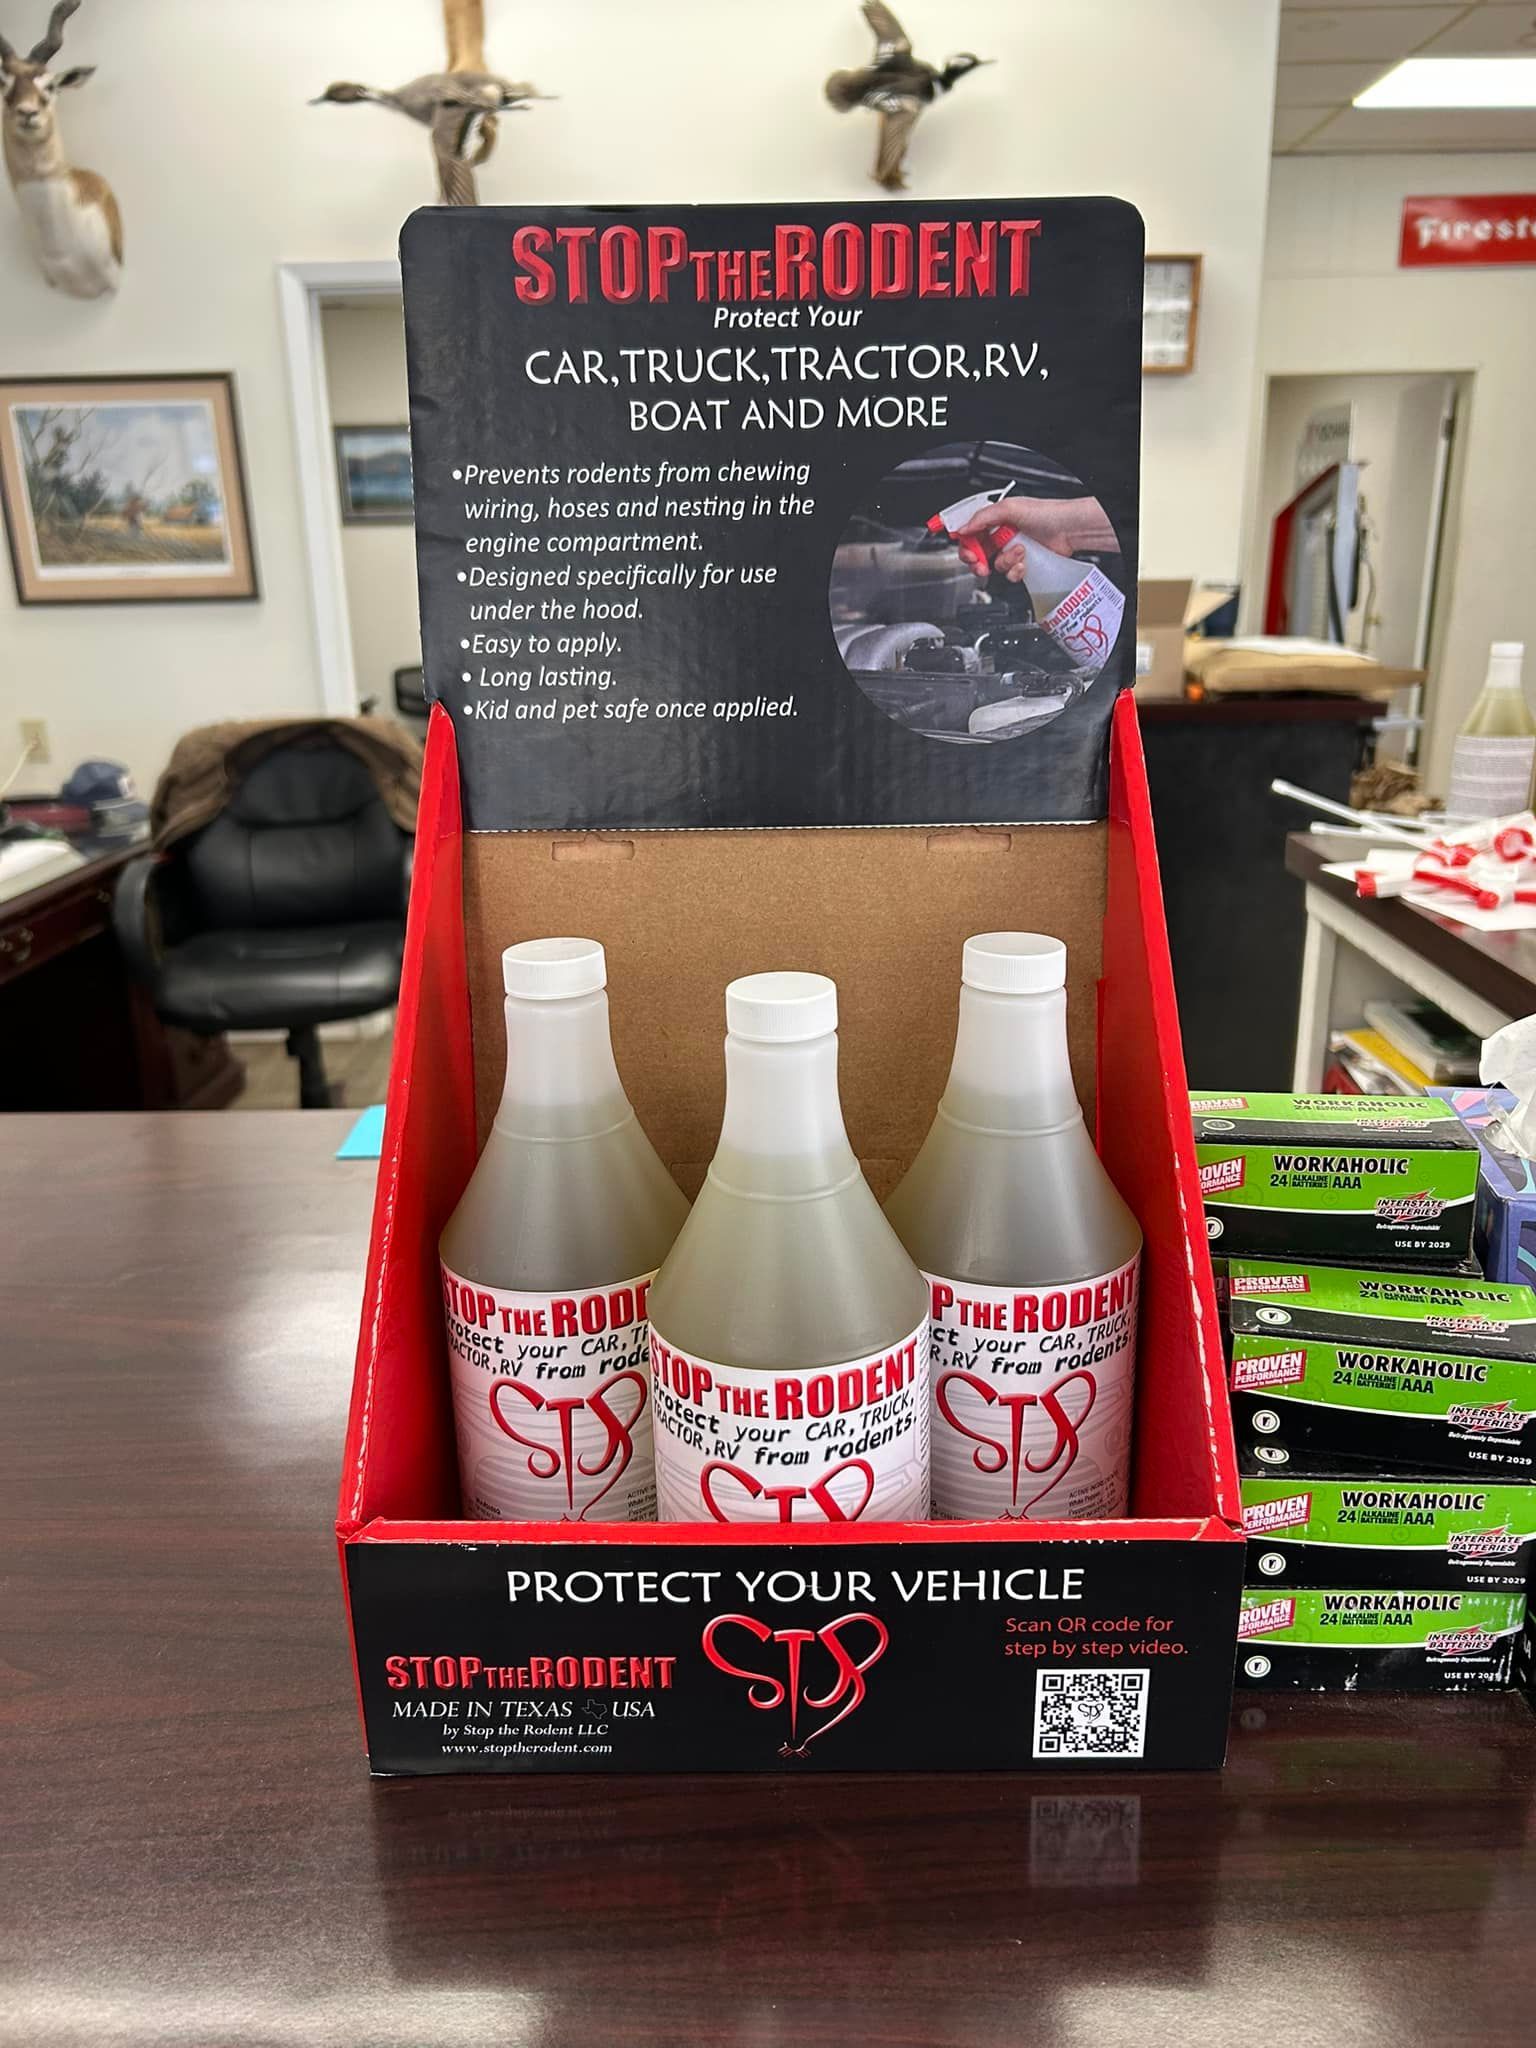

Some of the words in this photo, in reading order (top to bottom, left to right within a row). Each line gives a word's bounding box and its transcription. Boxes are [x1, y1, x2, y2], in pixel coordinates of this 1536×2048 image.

[1416, 216, 1536, 249] Firest
[713, 306, 799, 329] Protect
[806, 305, 863, 328] Your
[629, 400, 728, 432] BOAT
[740, 398, 825, 431] AND
[835, 396, 949, 429] MORE
[464, 464, 560, 485] Prevents
[567, 462, 651, 485] rodents
[655, 461, 711, 487] from
[717, 460, 811, 485] chewing
[464, 497, 540, 523] wiring,
[547, 498, 609, 518] hoses
[616, 495, 659, 518] and
[664, 494, 745, 520] nesting
[751, 495, 772, 516] in
[778, 493, 814, 516] the
[465, 532, 540, 557] engine
[547, 531, 703, 556] compartment.
[469, 565, 571, 590] Designed
[576, 563, 697, 589] specifically
[700, 563, 734, 588] for
[740, 566, 777, 584] use
[470, 600, 535, 621] under
[540, 599, 576, 620] the
[582, 598, 644, 619] hood.
[472, 634, 522, 657] Easy
[527, 635, 551, 654] to
[557, 632, 622, 657] apply.
[479, 667, 532, 691] Long
[538, 666, 617, 690] lasting.
[475, 699, 509, 720] Kid
[515, 699, 557, 720] and
[562, 701, 598, 723] pet
[603, 698, 649, 722] safe
[655, 701, 706, 718] once
[712, 696, 798, 722] applied.
[1199, 1159, 1242, 1181] OVEN
[1273, 1155, 1409, 1174] WORKAHOLIC
[1200, 1173, 1240, 1189] ORMANCE
[1270, 1174, 1288, 1187] 24
[1332, 1176, 1362, 1189] AAA
[1377, 1199, 1445, 1208] INTERSTATE
[1378, 1208, 1438, 1216] BATTERIES
[1234, 1275, 1304, 1286] PROVEN
[956, 1298, 1007, 1331] THE
[1013, 1262, 1136, 1333] RODENT
[1358, 1281, 1511, 1303] WORKAHOLIC
[1359, 1291, 1379, 1299] 24
[1430, 1297, 1464, 1306] AAA
[498, 1306, 547, 1337] THE
[550, 1280, 651, 1338] RODE
[518, 1343, 567, 1360] your
[974, 1334, 1026, 1353] your
[991, 1357, 1041, 1375] from
[1054, 1331, 1133, 1373] rodents.
[536, 1362, 585, 1379] from
[599, 1345, 649, 1375] rode
[1235, 1351, 1303, 1376] PROVEN
[1337, 1351, 1488, 1383] WORKAHOLIC
[651, 1333, 713, 1407] STOP
[715, 1382, 769, 1418] THE
[775, 1337, 918, 1420] RODENT
[1235, 1367, 1301, 1385] PERFORMANCE
[1333, 1371, 1352, 1385] 24
[1356, 1379, 1396, 1390] BATTERIES
[1358, 1373, 1397, 1384] ALKALINE
[1401, 1378, 1434, 1393] AAA
[653, 1376, 720, 1434] Protect
[734, 1424, 790, 1443] your
[1451, 1407, 1527, 1421] INTERSTATE
[1452, 1416, 1520, 1429] BATTERIES
[755, 1447, 808, 1466] from
[824, 1410, 917, 1462] rodents.
[1468, 1451, 1488, 1460] USE
[1490, 1454, 1505, 1462] BY
[1506, 1456, 1532, 1465] 2029
[1243, 1494, 1308, 1522] PROVEN
[1341, 1491, 1485, 1511] WORKAHOLIC
[1337, 1511, 1356, 1523] 24
[1360, 1516, 1399, 1524] BATTERIES
[1403, 1512, 1434, 1525] AAA
[1450, 1535, 1522, 1544] INTERSTATE
[1451, 1544, 1516, 1552] BATTERIES
[507, 1570, 721, 1603] PROTECT
[736, 1570, 876, 1603] YOUR
[892, 1568, 1085, 1601] VEHICLE
[1502, 1576, 1527, 1584] 2029
[1239, 1600, 1291, 1625] ROVEN
[1324, 1595, 1460, 1611] WORKAHOLIC
[1005, 1617, 1052, 1632] Scan
[1058, 1617, 1087, 1633] QR
[1091, 1616, 1140, 1632] code
[1145, 1616, 1174, 1631] for
[1239, 1613, 1290, 1633] RFORMANCE
[1320, 1613, 1338, 1625] 24
[1383, 1613, 1413, 1625] AAA
[1428, 1634, 1497, 1642] INTERSTATE
[1004, 1641, 1047, 1658] step
[1052, 1640, 1075, 1658] by
[1080, 1641, 1124, 1658] step
[1129, 1640, 1189, 1656] video.
[393, 1700, 459, 1718] MADE
[467, 1700, 493, 1718] IN
[501, 1700, 573, 1718] TEXAS
[612, 1700, 656, 1718] USA
[443, 1723, 460, 1738] by
[464, 1723, 495, 1738] Stop
[498, 1723, 520, 1736] the
[524, 1723, 575, 1736] Rodent
[578, 1723, 609, 1736] LLC
[441, 1741, 613, 1756] www.stoptherodent.com
